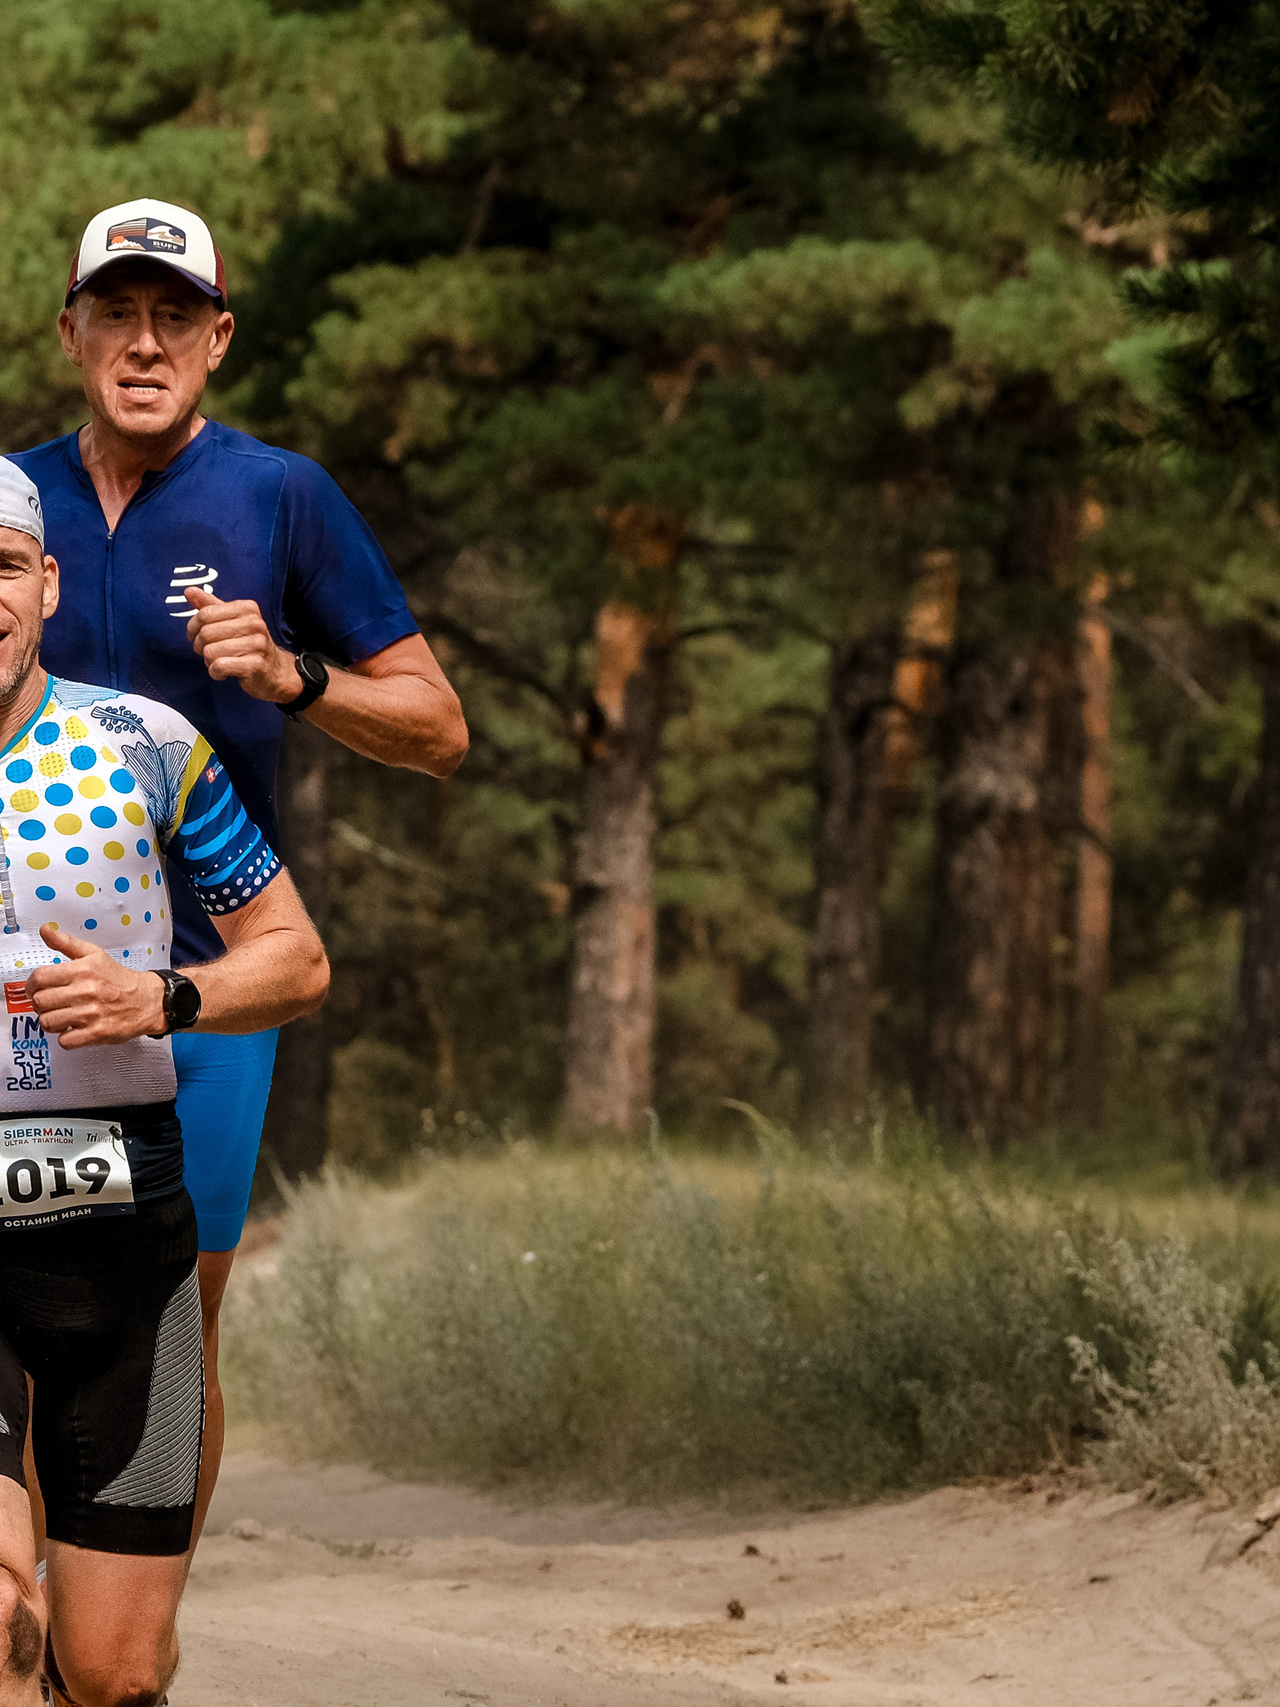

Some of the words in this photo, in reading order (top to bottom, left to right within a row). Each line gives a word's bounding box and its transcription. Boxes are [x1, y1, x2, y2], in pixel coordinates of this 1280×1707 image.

[12, 1015, 45, 1040] I'M
[12, 1038, 48, 1050] KONA
[6, 1077, 47, 1091] 26.2
[4, 1128, 74, 1139] SIBERMAN
[5, 1139, 29, 1147] ULTRA
[4, 1214, 58, 1227] ОСТАНИН
[61, 1208, 91, 1219] ИВАН
